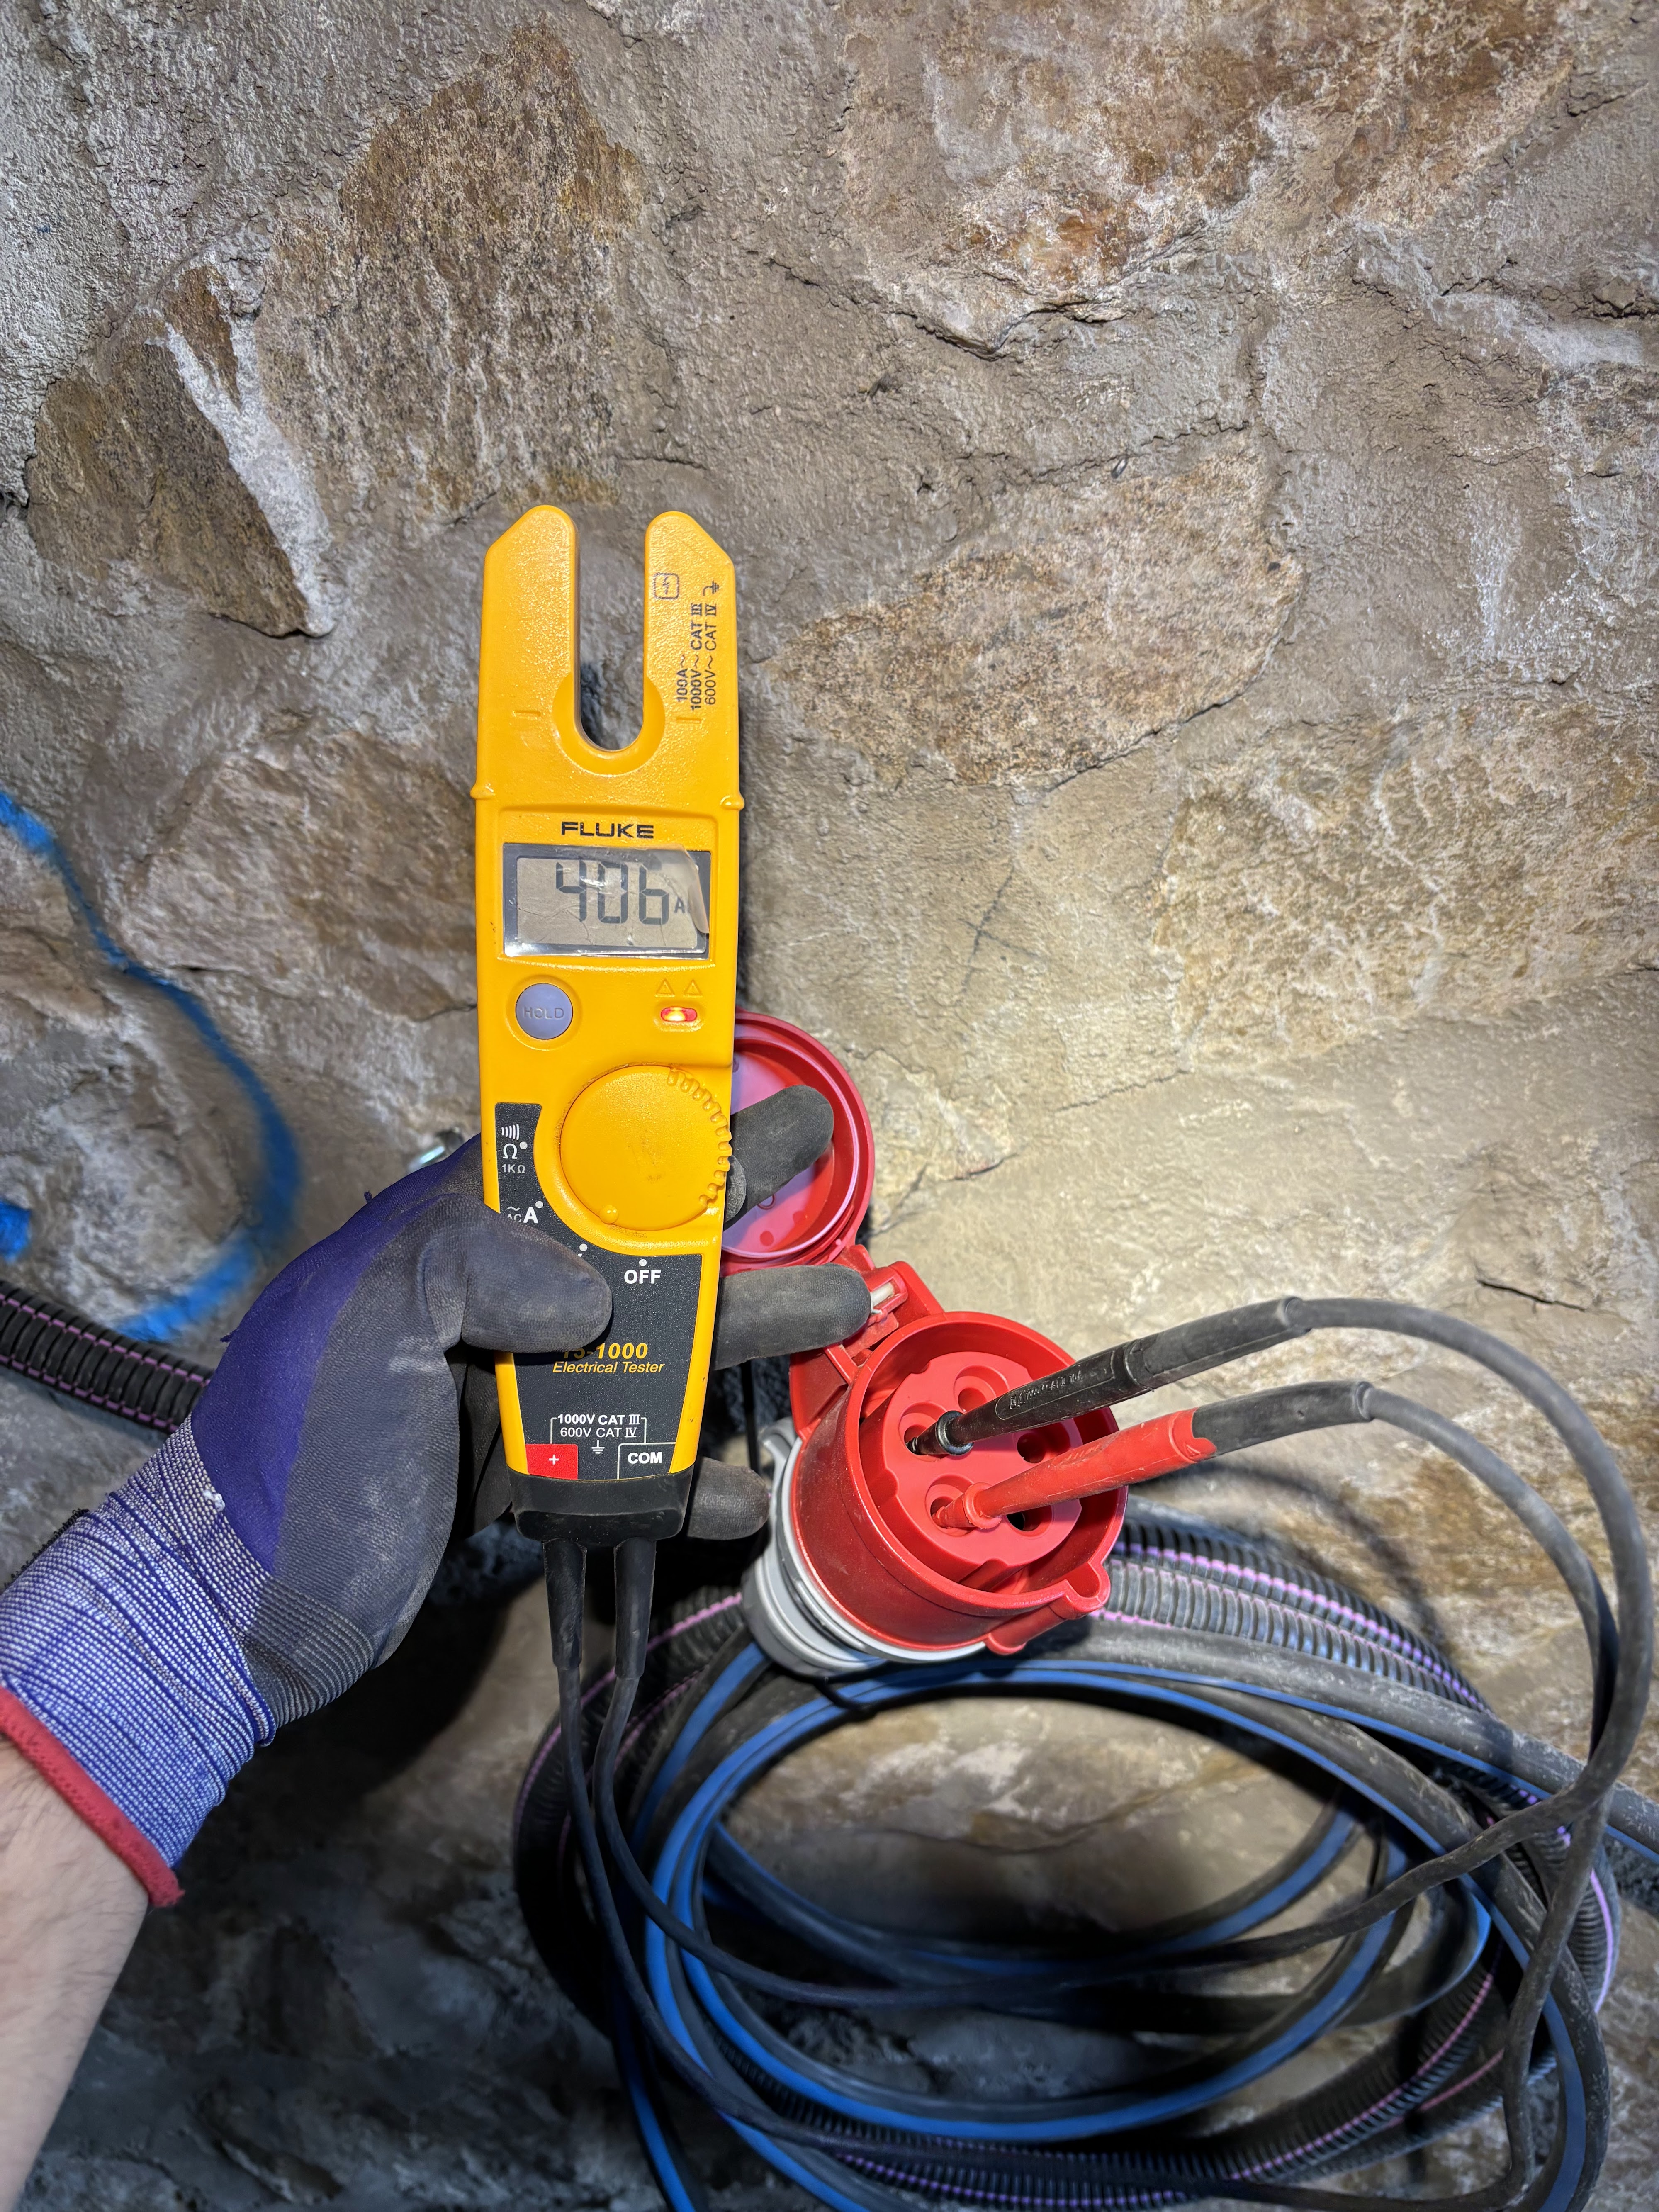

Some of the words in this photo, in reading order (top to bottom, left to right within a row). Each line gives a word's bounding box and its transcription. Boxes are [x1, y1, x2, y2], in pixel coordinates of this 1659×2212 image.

[705, 603, 717, 616] IV
[690, 622, 702, 650] CAT
[705, 622, 717, 651] CAT
[561, 821, 654, 839] FLUKE
[556, 859, 669, 925] 406
[523, 1007, 564, 1020] HOLD
[523, 1207, 539, 1224] A
[624, 1269, 662, 1284] OFF
[552, 1361, 618, 1374] Electrical
[622, 1361, 665, 1374] Tester
[557, 1414, 595, 1425] 1000V
[598, 1414, 625, 1425] CAT
[628, 1414, 640, 1425] III
[560, 1427, 591, 1438] 600V
[596, 1427, 622, 1438] CAT
[625, 1427, 637, 1438] IV
[627, 1452, 662, 1464] COM
